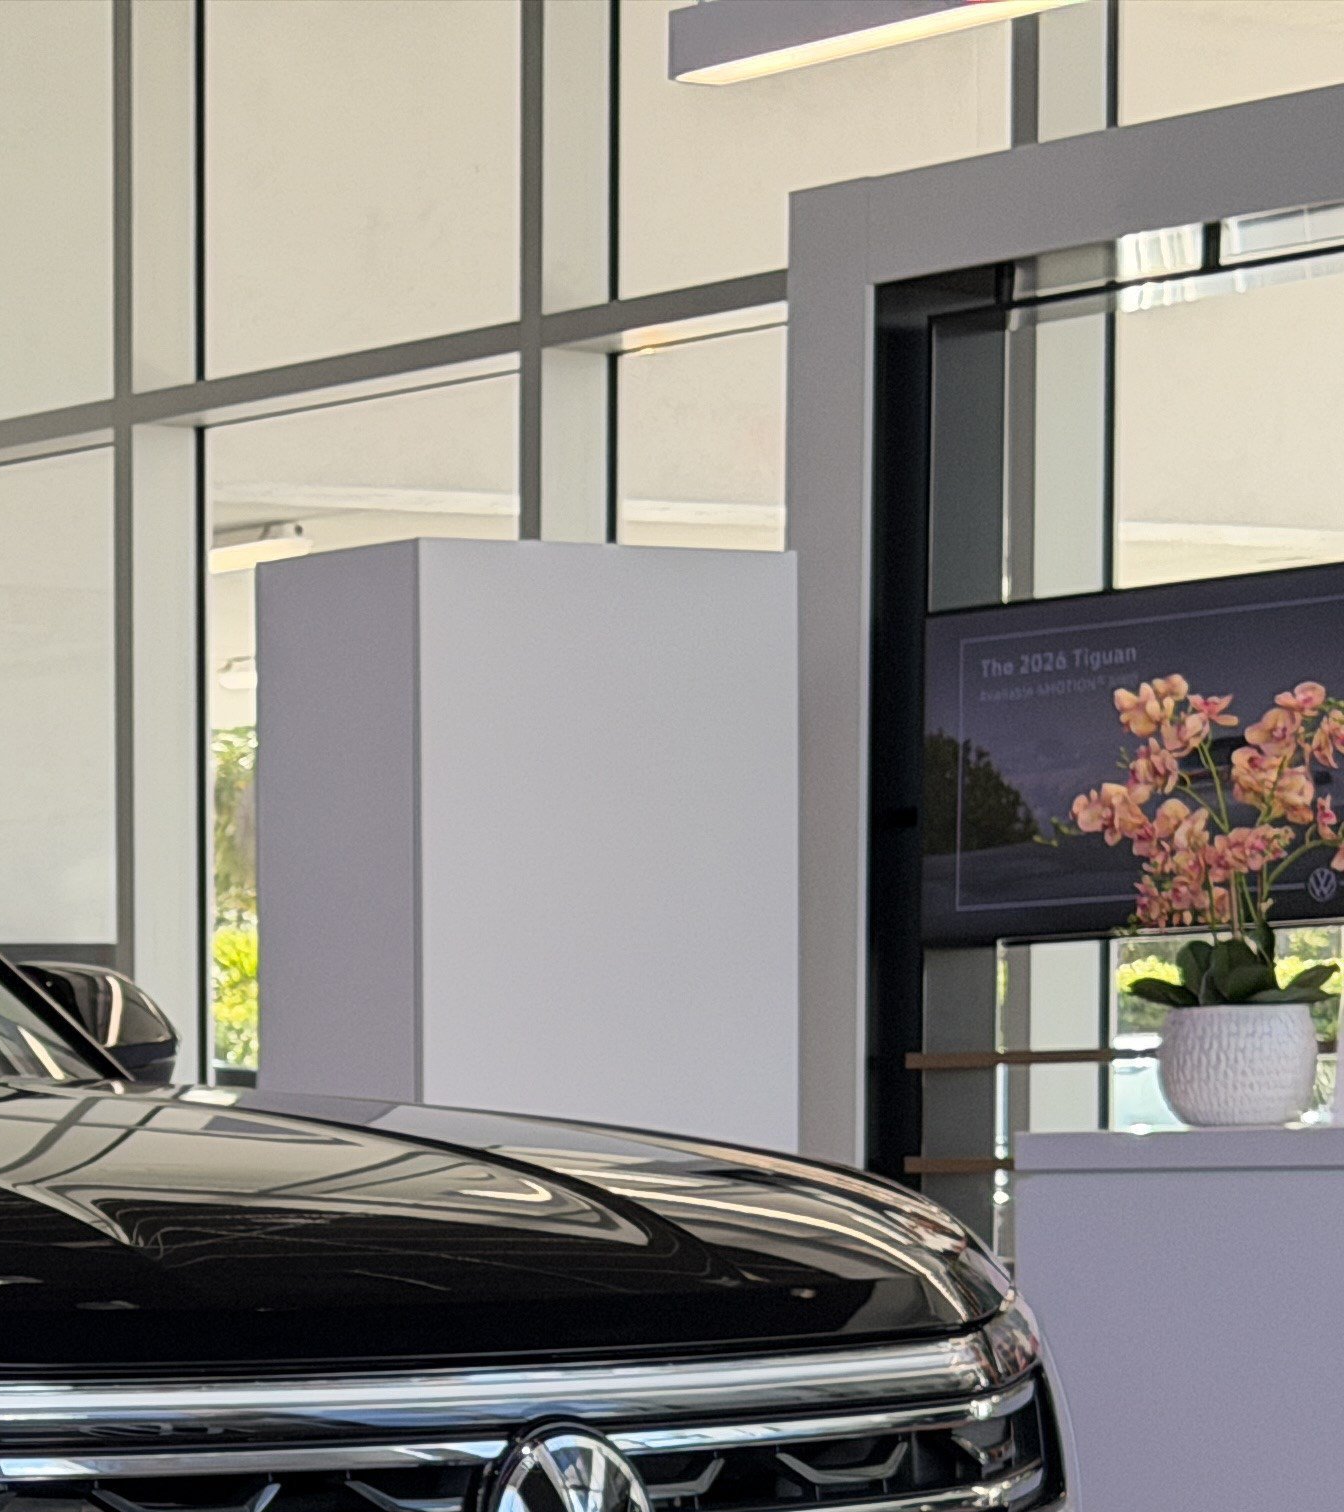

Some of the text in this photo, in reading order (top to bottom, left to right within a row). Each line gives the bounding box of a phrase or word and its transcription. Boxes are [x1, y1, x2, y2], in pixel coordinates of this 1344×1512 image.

[981, 647, 1137, 678] The 2026 Tiguan
